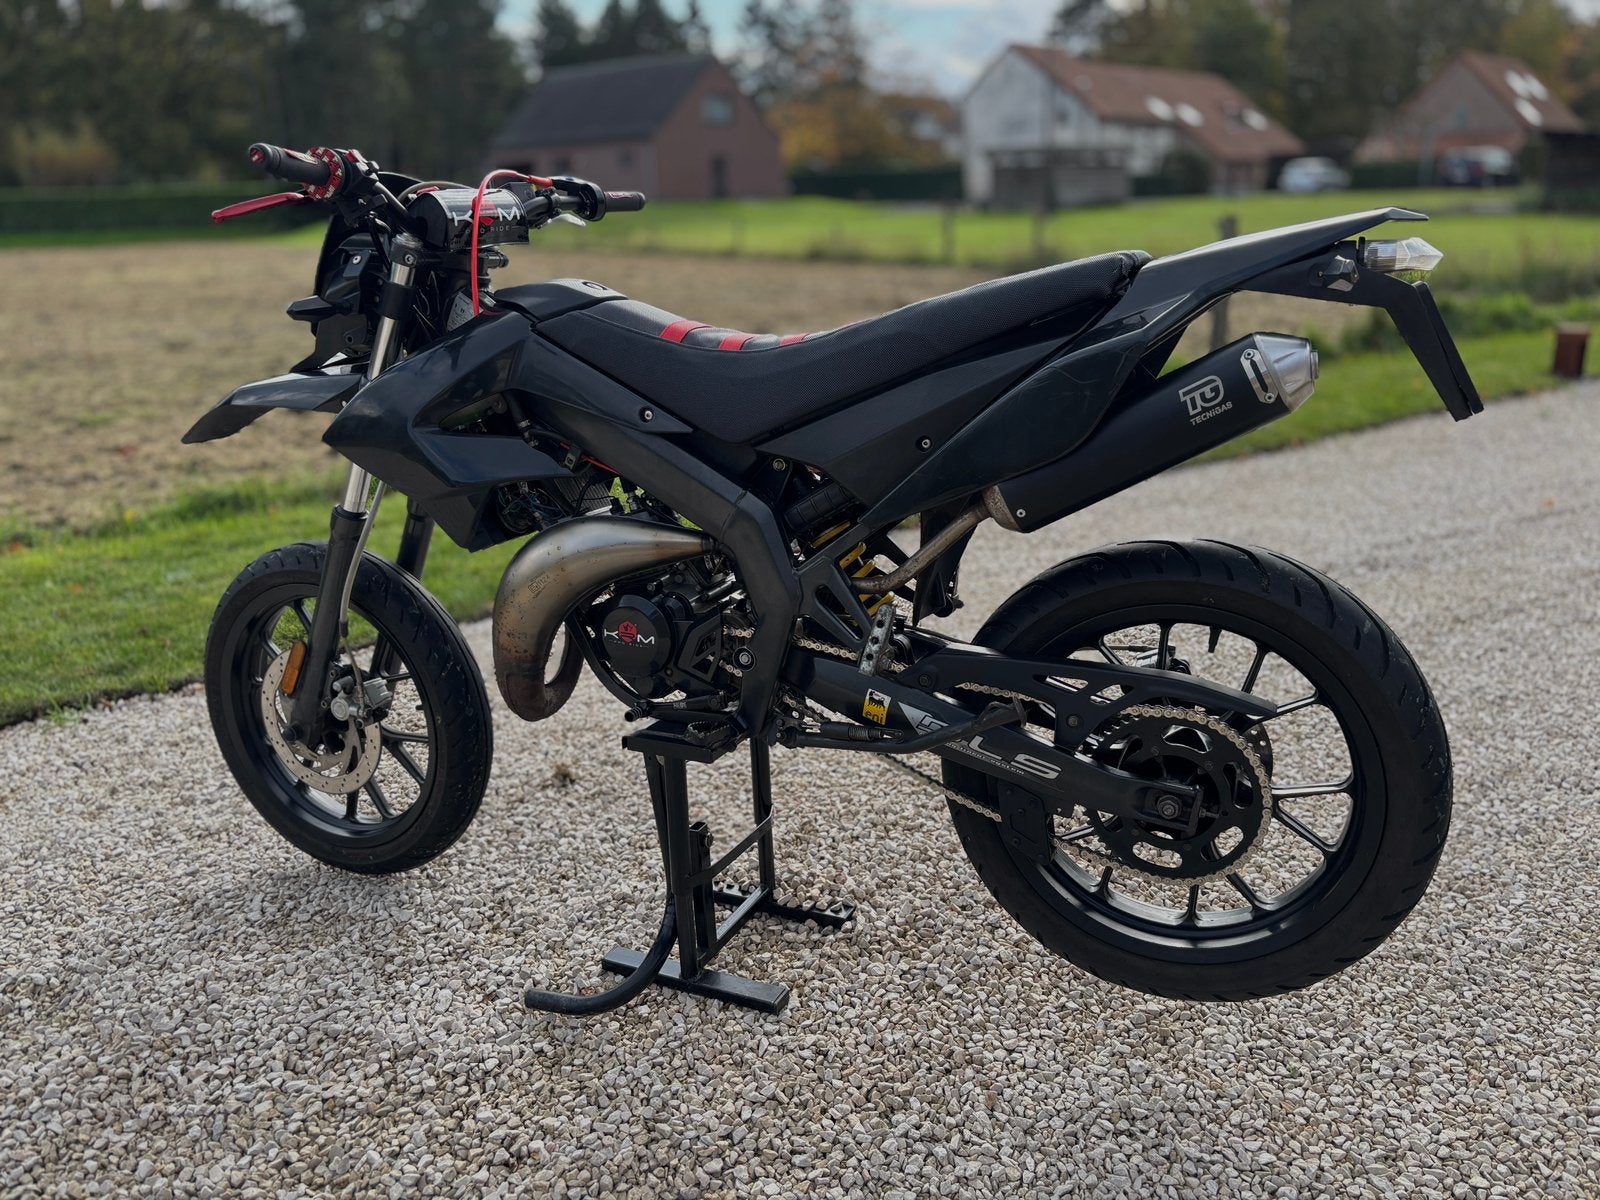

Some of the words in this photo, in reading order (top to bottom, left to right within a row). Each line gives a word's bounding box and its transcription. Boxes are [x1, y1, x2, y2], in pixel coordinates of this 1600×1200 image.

[452, 197, 520, 227] KM
[466, 227, 485, 236] PO
[865, 710, 884, 724] eni
